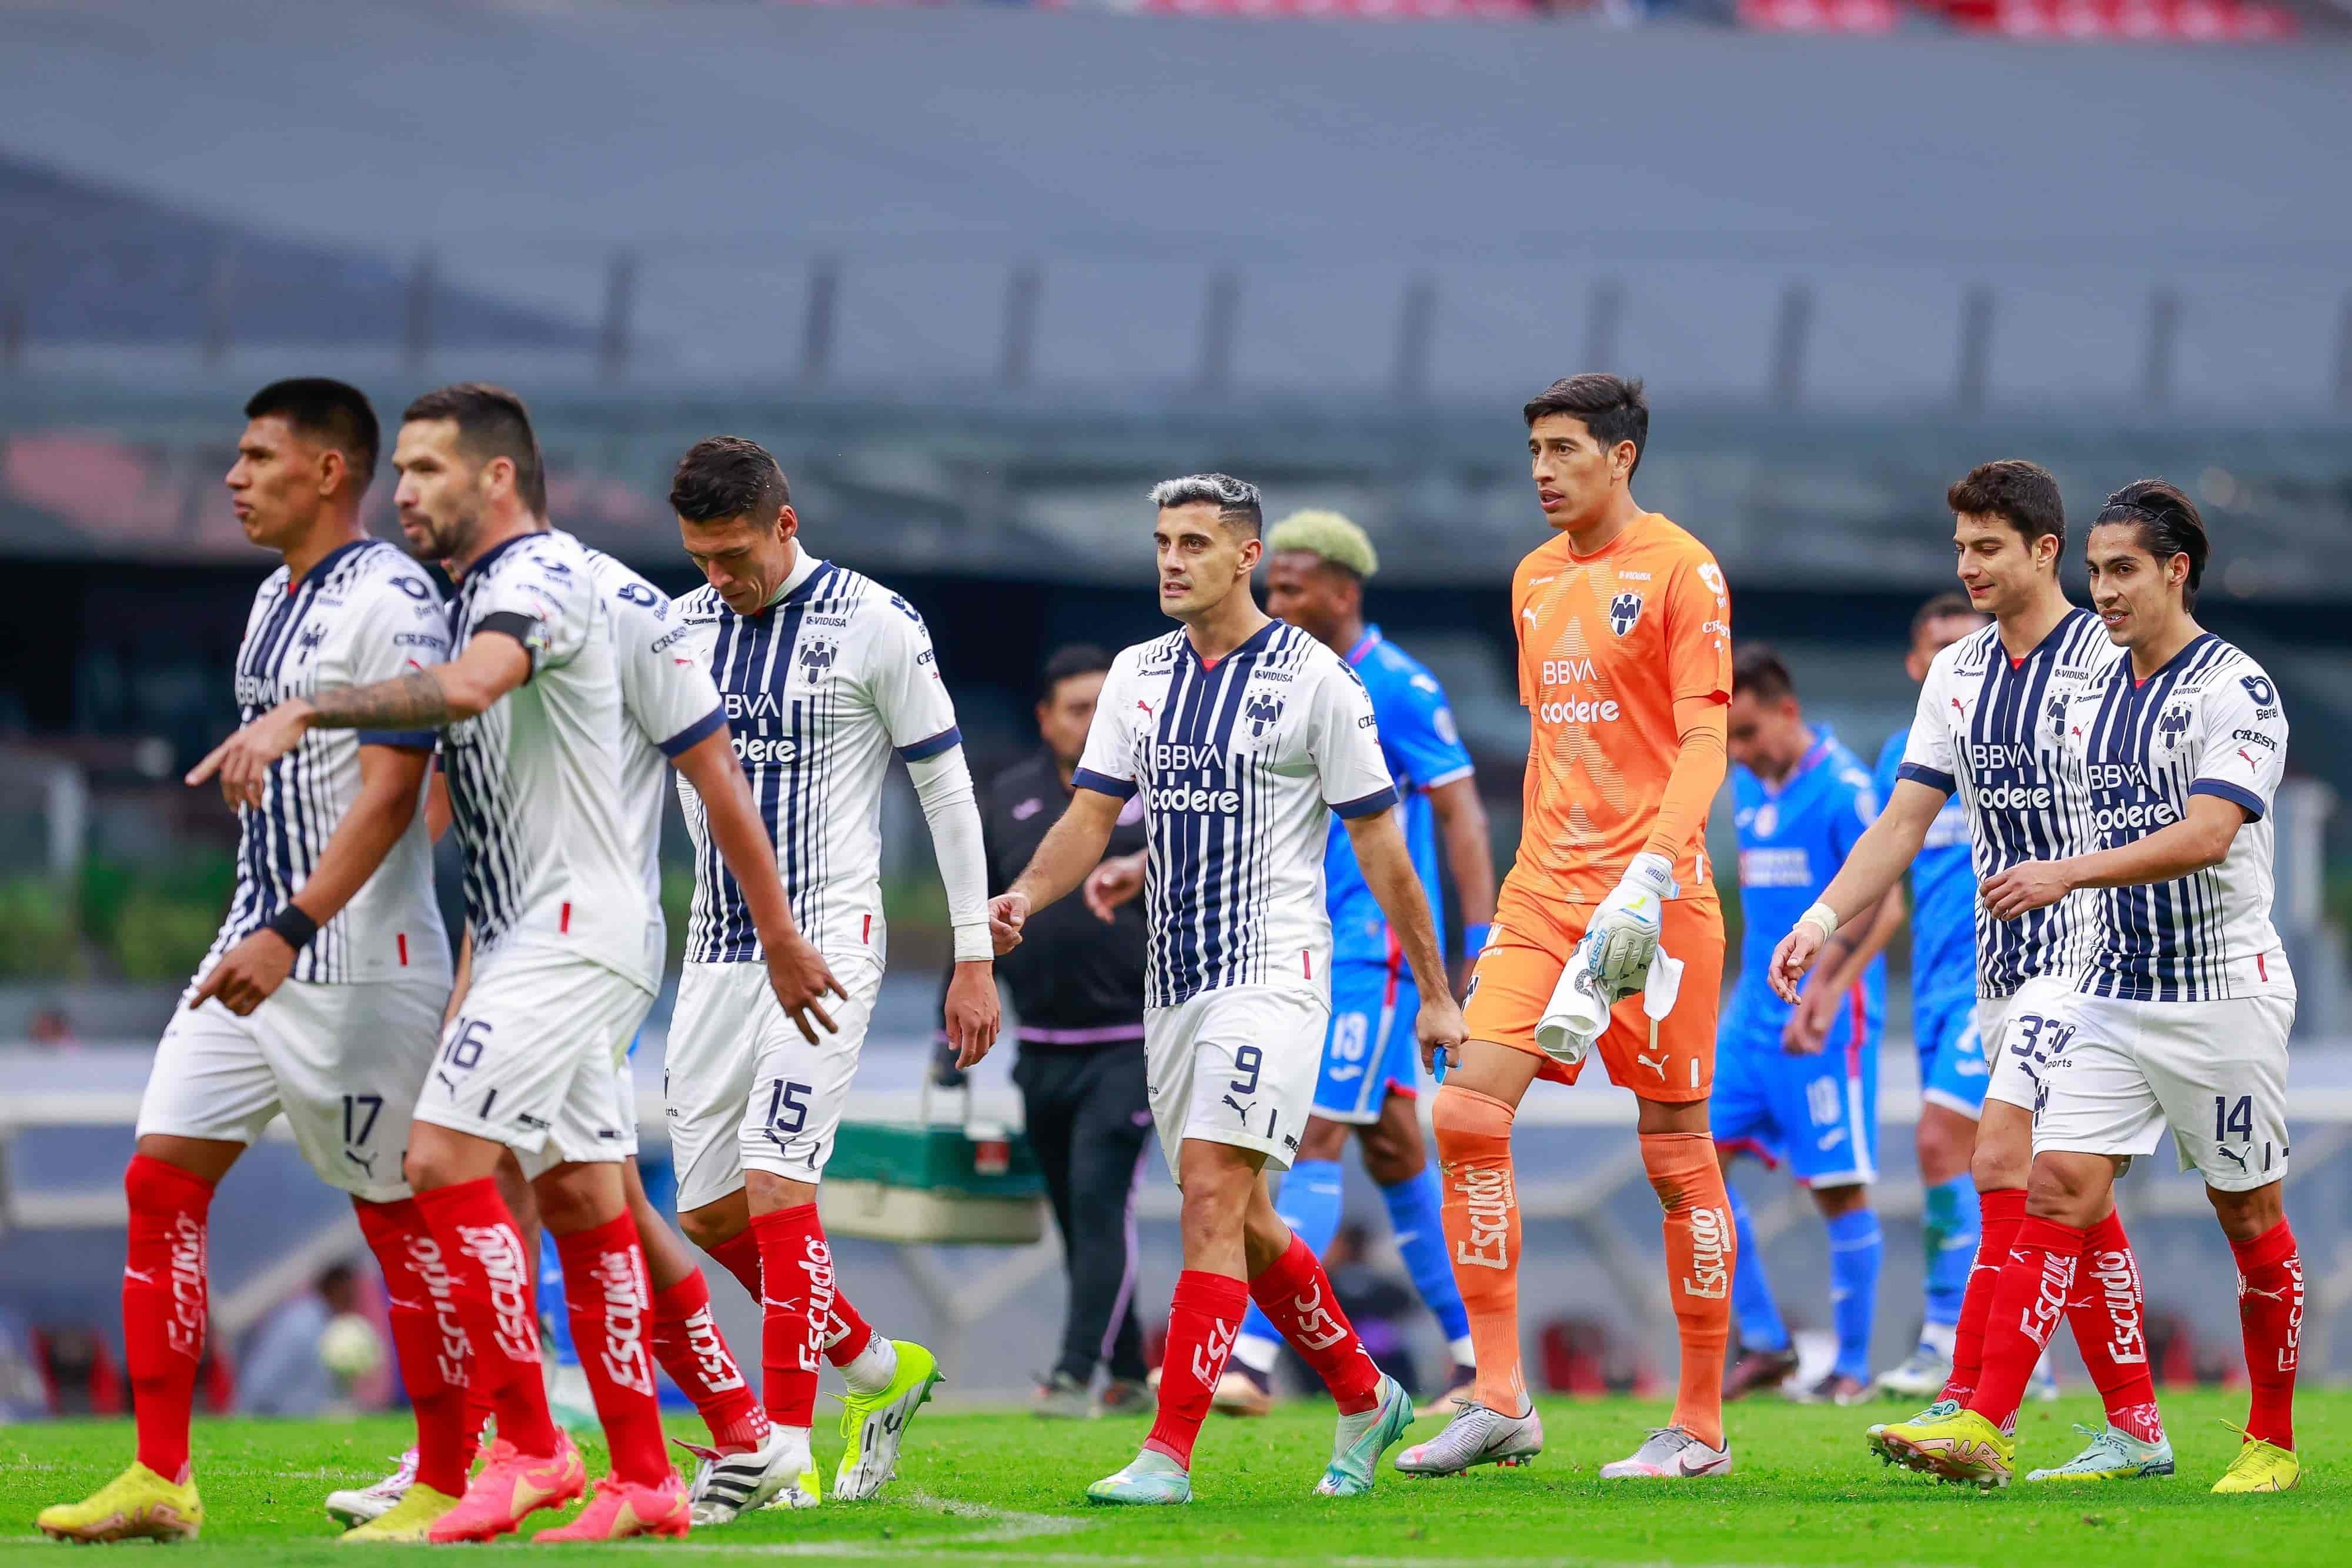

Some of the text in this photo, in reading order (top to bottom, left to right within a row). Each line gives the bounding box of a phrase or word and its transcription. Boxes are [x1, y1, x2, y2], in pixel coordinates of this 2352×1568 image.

[814, 617, 847, 628] VIDUSA
[1262, 671, 1294, 683] VIDUSA
[1542, 657, 1599, 686] BBVA
[2061, 669, 2088, 680] VIDUSA
[724, 692, 781, 720] BVA
[1540, 693, 1620, 724] codere
[2256, 705, 2278, 721] Berel
[730, 730, 797, 763] dere
[1157, 743, 1224, 771] BBVA
[1972, 742, 2035, 769] BBVA
[2232, 729, 2277, 753] CREST
[1150, 781, 1240, 814] codere
[1976, 780, 2051, 810] odere
[2087, 761, 2150, 791] BBVA
[2092, 798, 2175, 831] odere
[443, 1017, 493, 1069] 16
[2045, 1058, 2073, 1070] ports
[1230, 1045, 1262, 1095] 9
[342, 1095, 385, 1146] 17
[765, 1079, 813, 1133] 15
[2214, 1095, 2253, 1142] 14
[1454, 1169, 1510, 1271] Escudo
[1683, 1208, 1728, 1299] Escudo
[2122, 1248, 2143, 1303] Antibacterial
[459, 1226, 540, 1363] Escudo
[797, 1239, 833, 1375] Escudo
[1294, 1281, 1348, 1350] Esc
[2019, 1251, 2070, 1352] Escu
[2088, 1251, 2146, 1364] Escudo
[2278, 1252, 2305, 1372] Escud
[589, 1252, 654, 1397] Escudo
[684, 1306, 745, 1393] Escu
[1192, 1318, 1240, 1393] Esc
